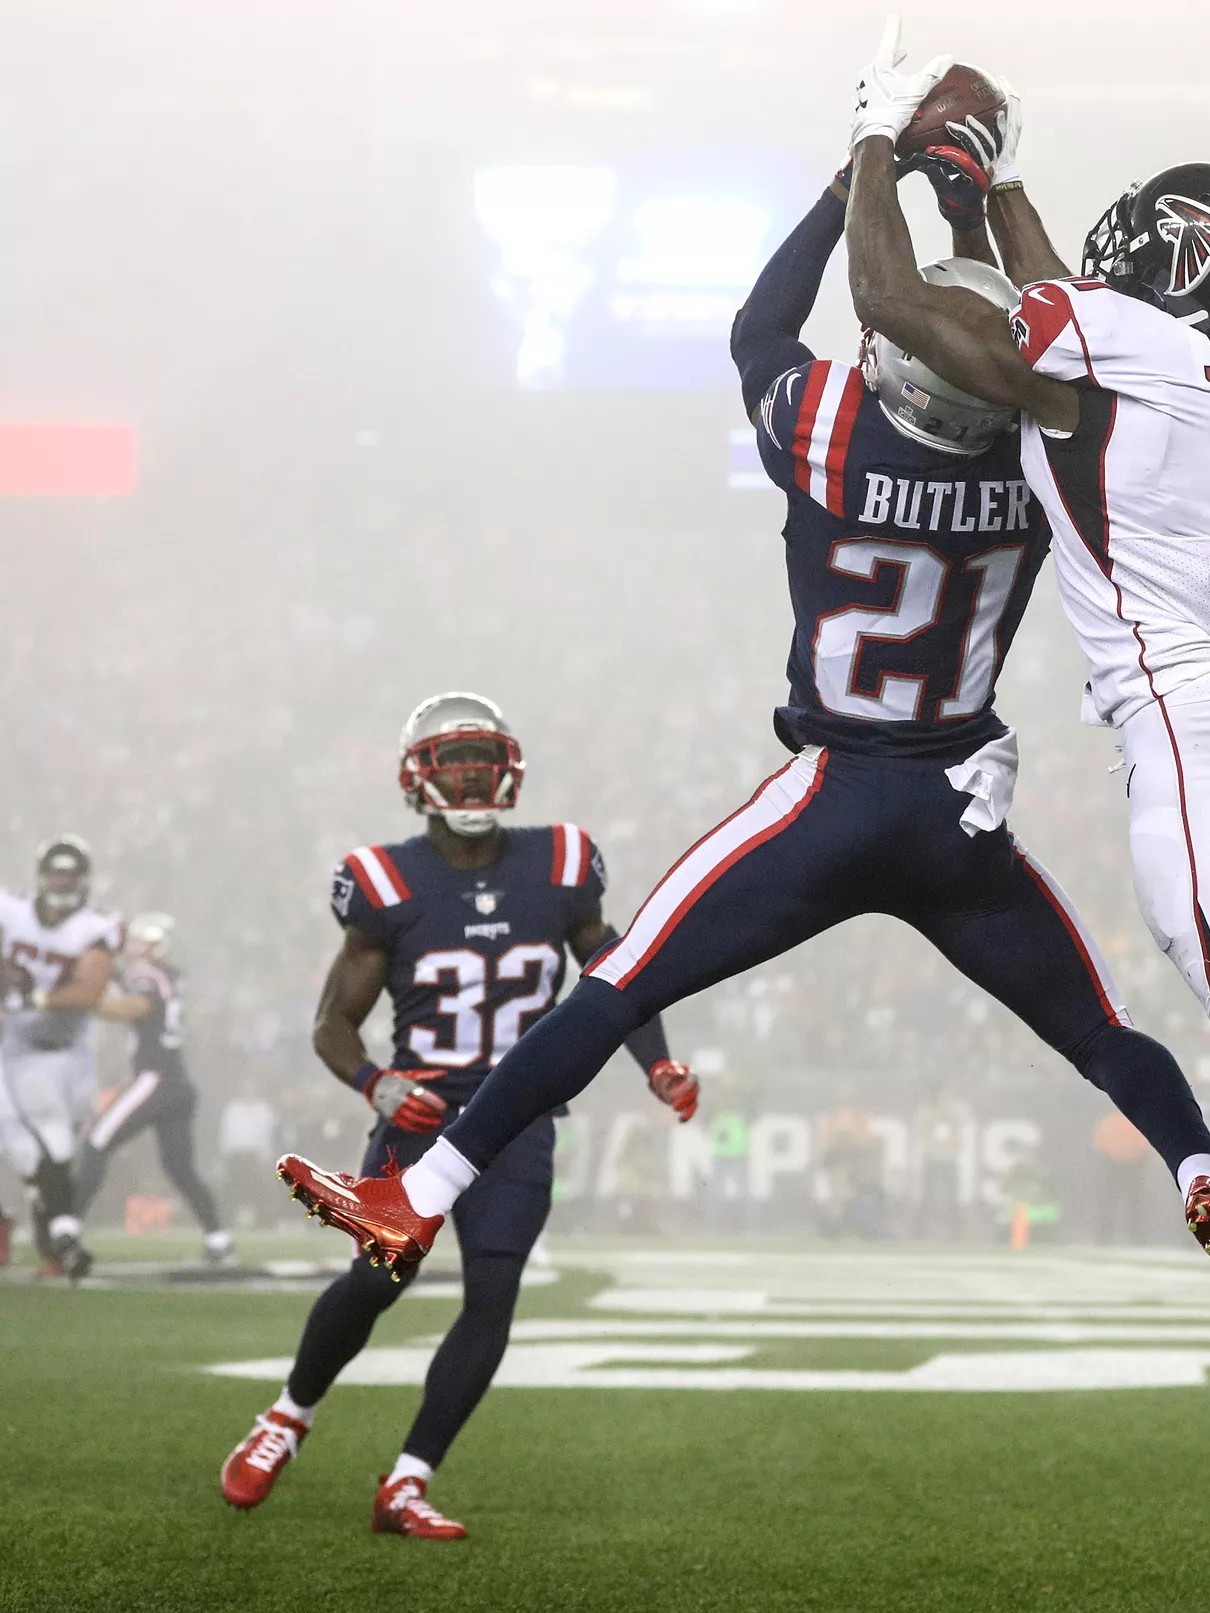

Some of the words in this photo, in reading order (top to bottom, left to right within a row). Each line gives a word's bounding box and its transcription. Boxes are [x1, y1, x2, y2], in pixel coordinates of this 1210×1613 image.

[858, 472, 1031, 532] BUTLER
[812, 536, 1029, 723] 21
[409, 942, 561, 1068] 32
